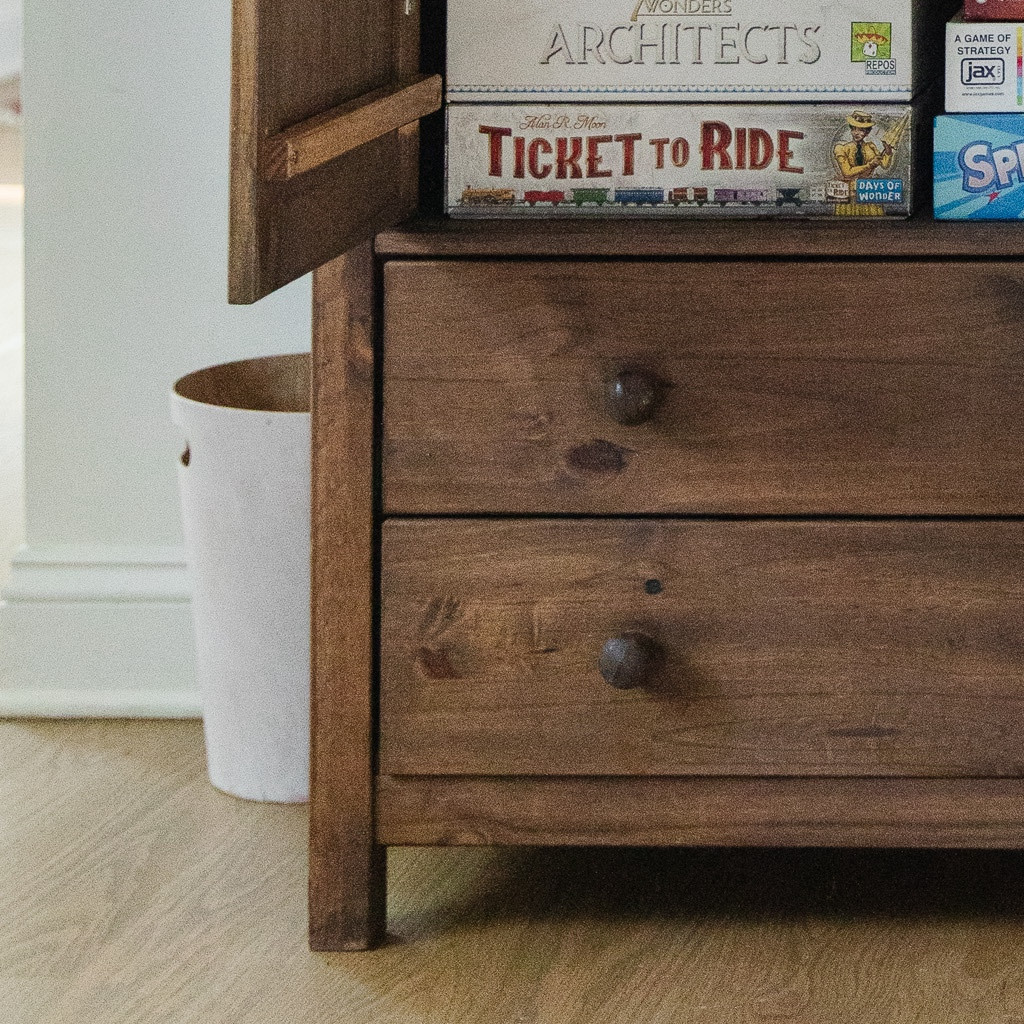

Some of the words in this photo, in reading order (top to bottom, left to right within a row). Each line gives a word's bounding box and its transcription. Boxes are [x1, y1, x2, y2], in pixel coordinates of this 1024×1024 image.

[964, 34, 994, 43] GAME
[997, 34, 1011, 42] OF
[539, 23, 821, 65] ARCHITECTS
[957, 46, 1011, 55] STRATEGY
[866, 60, 895, 70] REPOS
[966, 61, 996, 82] jax
[519, 114, 551, 130] Alan
[574, 115, 607, 130] Moon
[478, 123, 643, 180] TICKET
[649, 136, 690, 169] TO
[699, 120, 804, 174] RIDE
[859, 181, 884, 190] DAYS
[886, 181, 900, 190] OF
[859, 191, 901, 201] WONDER
